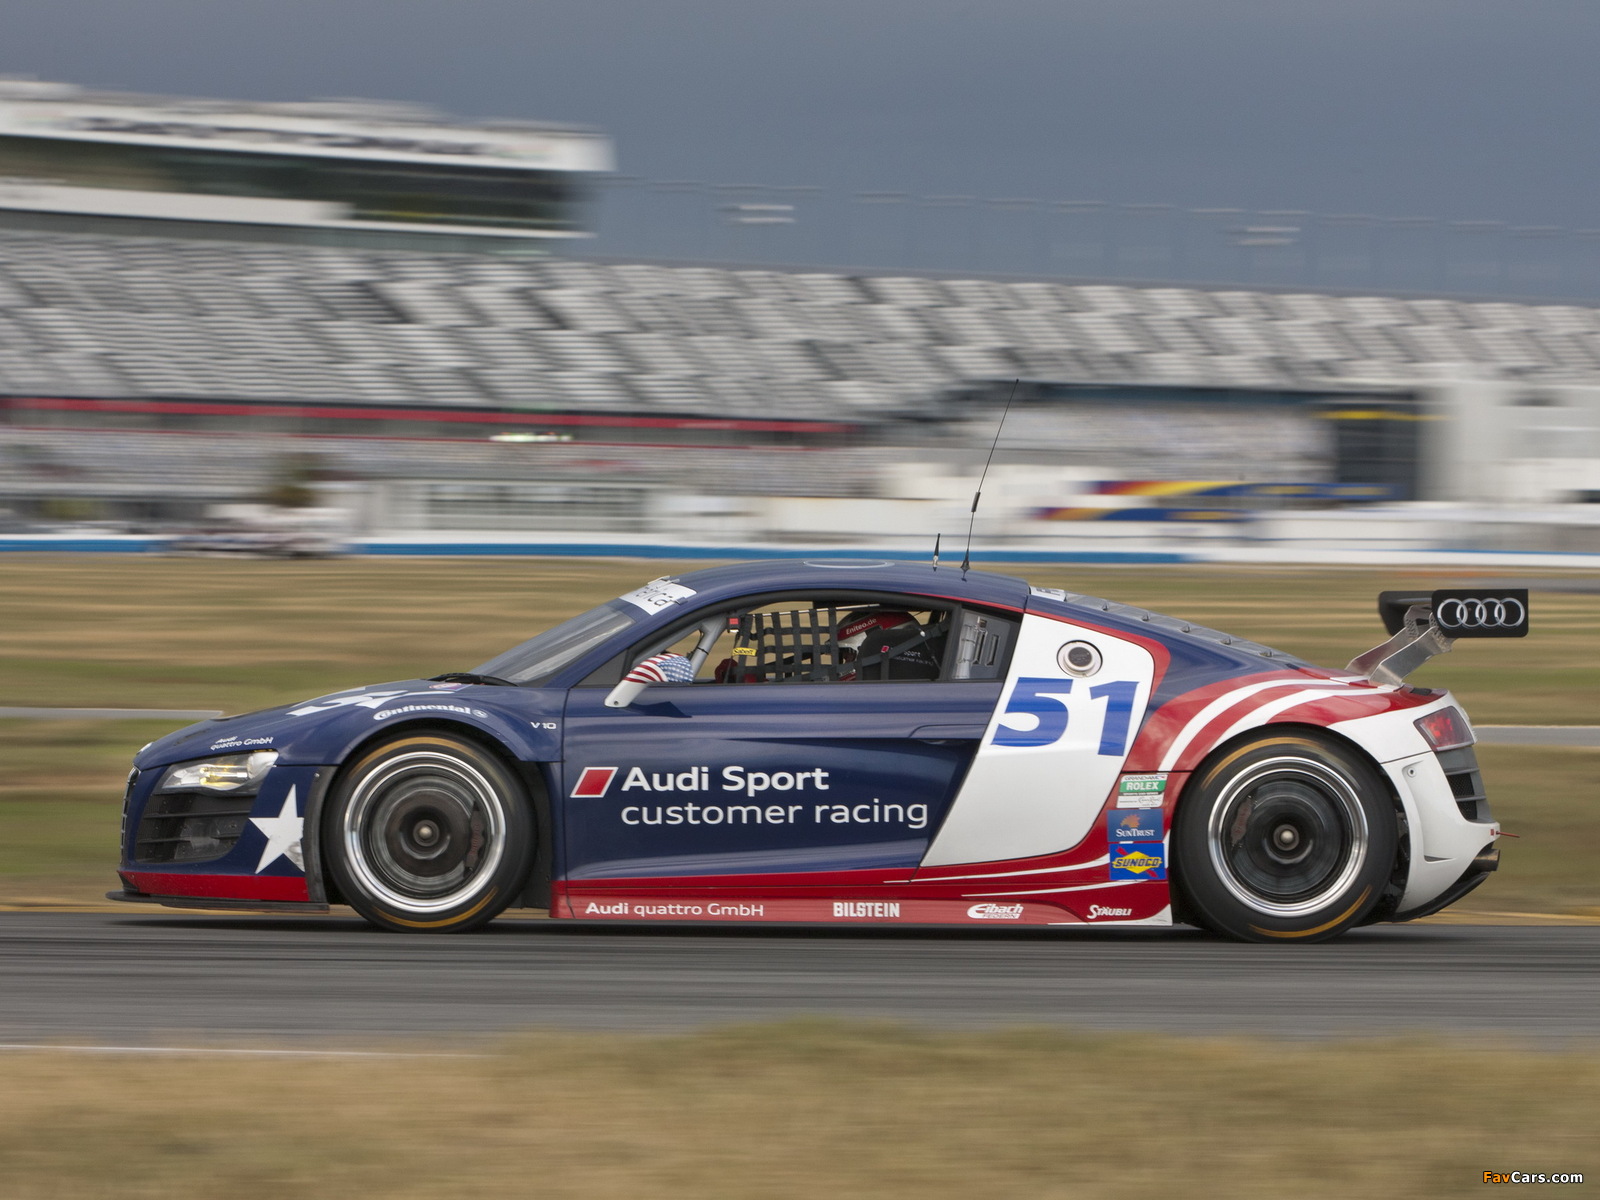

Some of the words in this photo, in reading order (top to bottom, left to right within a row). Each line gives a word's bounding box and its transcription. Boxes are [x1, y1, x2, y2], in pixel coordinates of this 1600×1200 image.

[373, 705, 472, 721] Continental
[990, 676, 1140, 757] 51
[210, 741, 243, 751] quattro
[243, 736, 274, 746] GmbH
[621, 766, 709, 791] Audi
[721, 766, 829, 797] Sport
[1126, 781, 1160, 791] ROLEX
[620, 801, 802, 825] customer
[814, 798, 929, 829] racing
[1115, 858, 1161, 867] SUNOCO
[586, 902, 629, 915] Audi
[633, 903, 703, 918] quattro
[706, 902, 764, 916] GmbH
[833, 902, 900, 917] BILSTEIN
[967, 903, 1024, 919] Eibach
